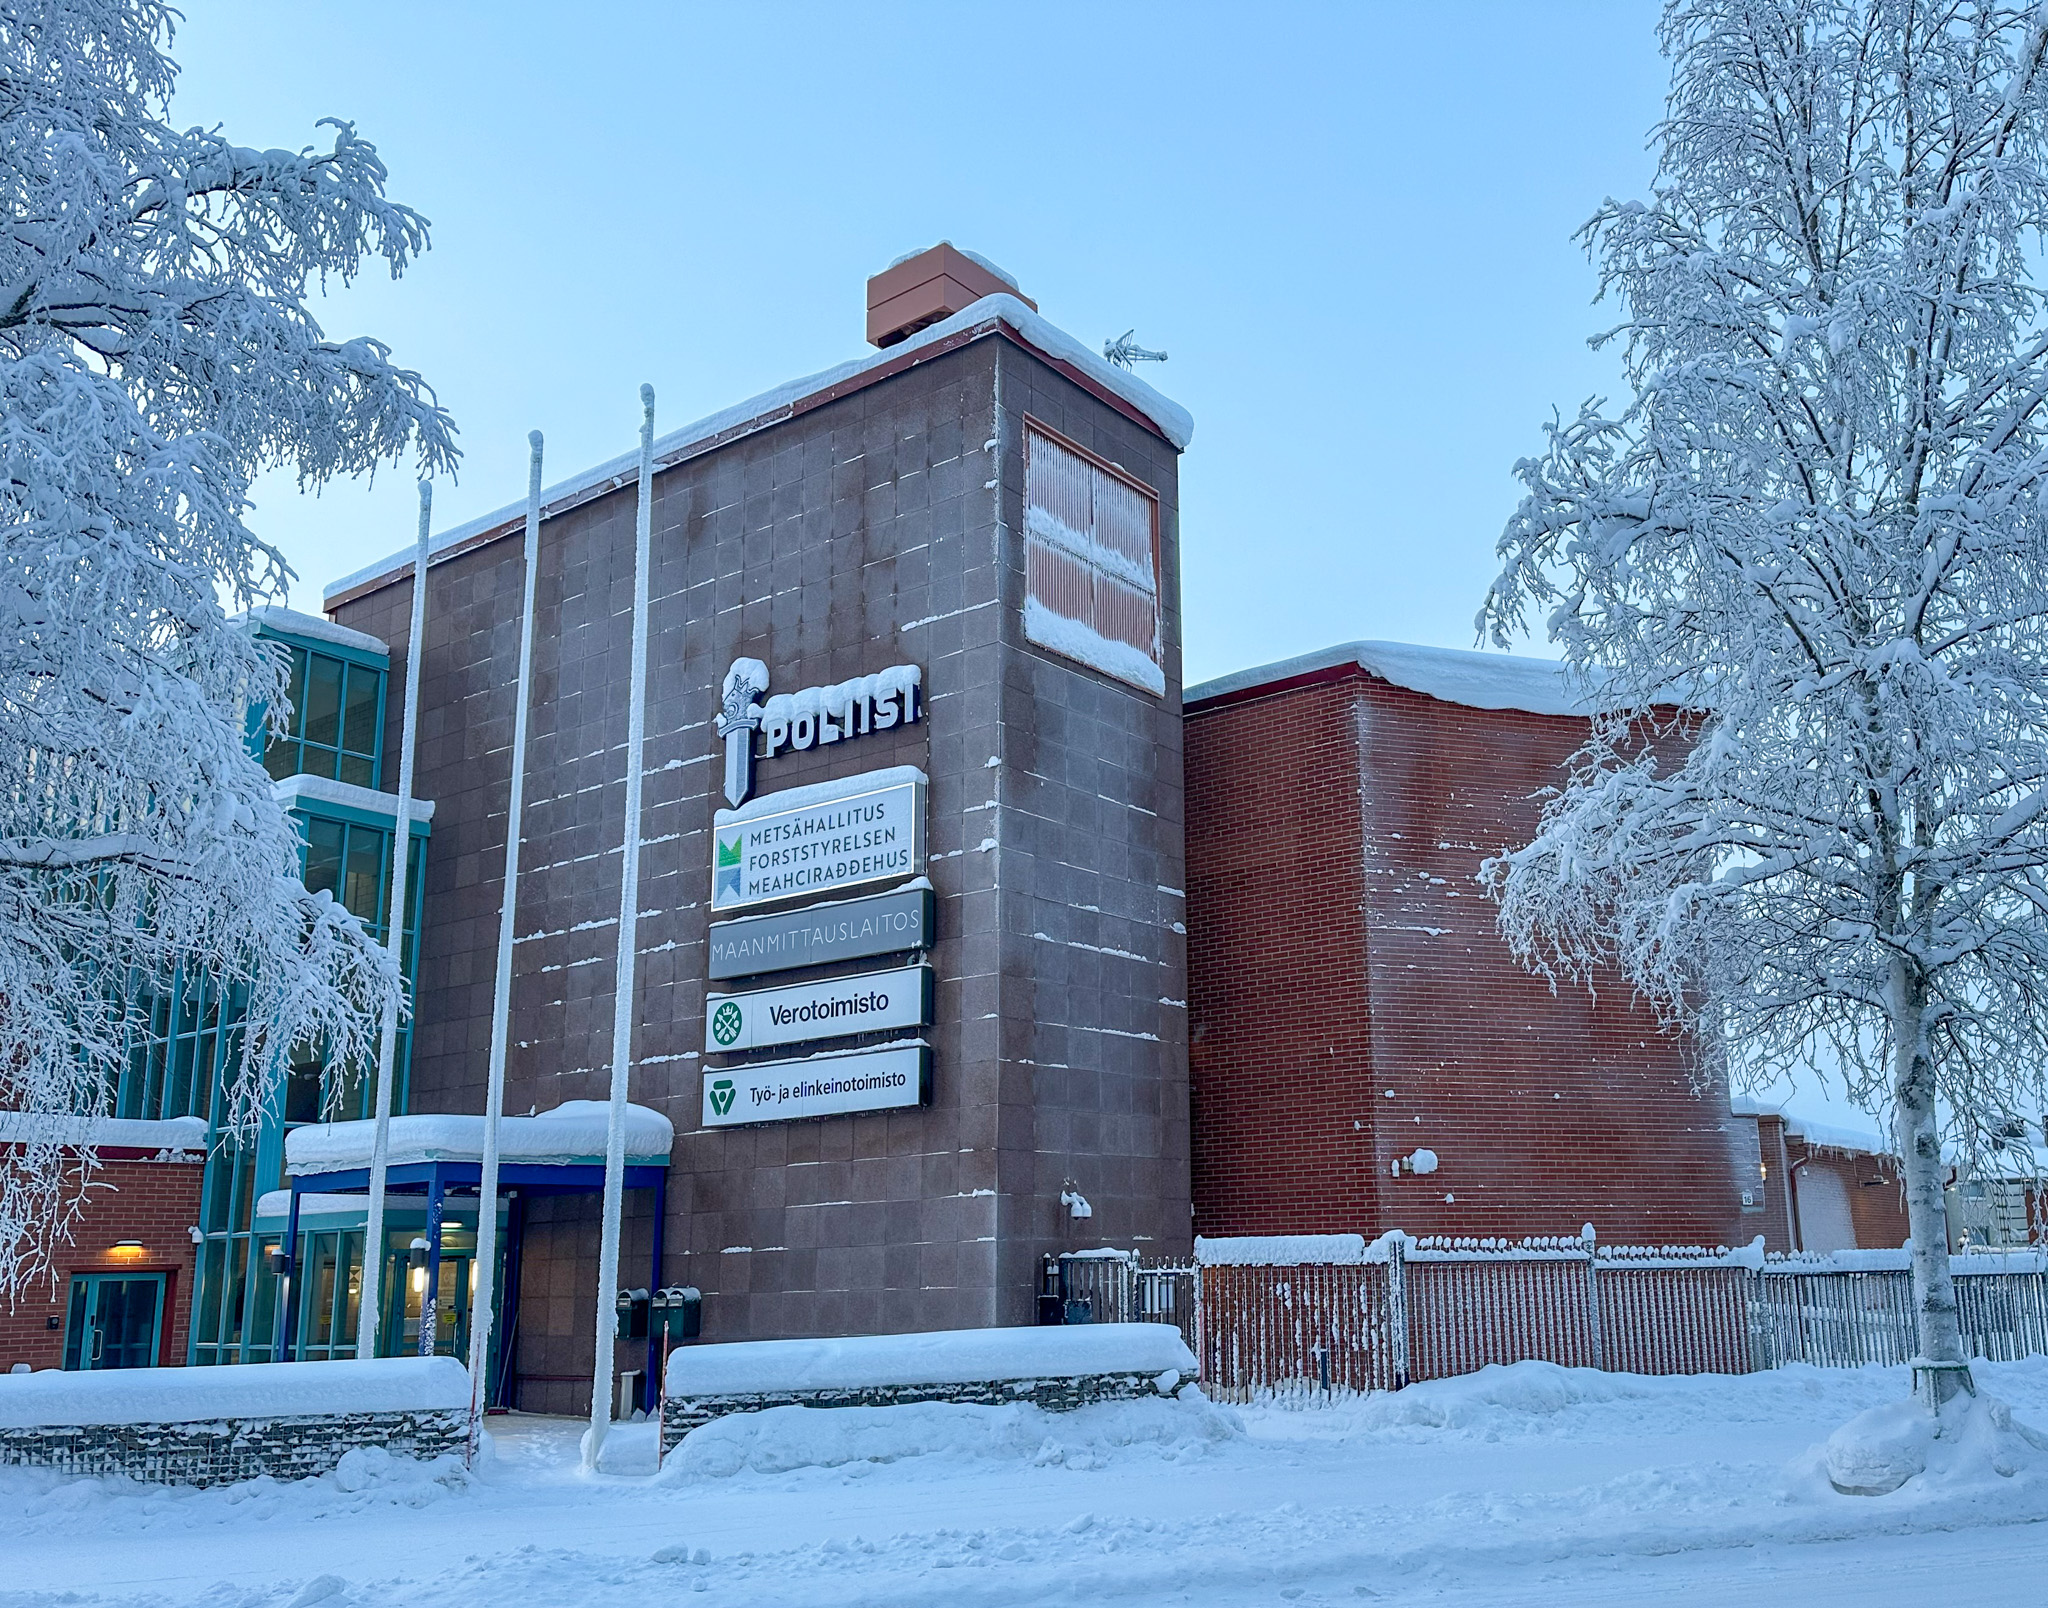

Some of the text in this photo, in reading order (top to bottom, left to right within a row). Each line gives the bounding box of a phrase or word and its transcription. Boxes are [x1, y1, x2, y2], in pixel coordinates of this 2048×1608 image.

[766, 683, 915, 758] POLIISI
[750, 803, 885, 847] METSÄHALLITUS
[749, 826, 896, 871] FORSTSTYRELSEN
[748, 849, 908, 896] MEAHCIRAĐĐEHUS
[711, 909, 920, 963] MAANMITTAUSLAITOS
[769, 990, 889, 1026] Verotoimisto
[750, 1071, 906, 1106] Työ- ja elinkeinotoimisto
[1744, 1196, 1752, 1204] 16
